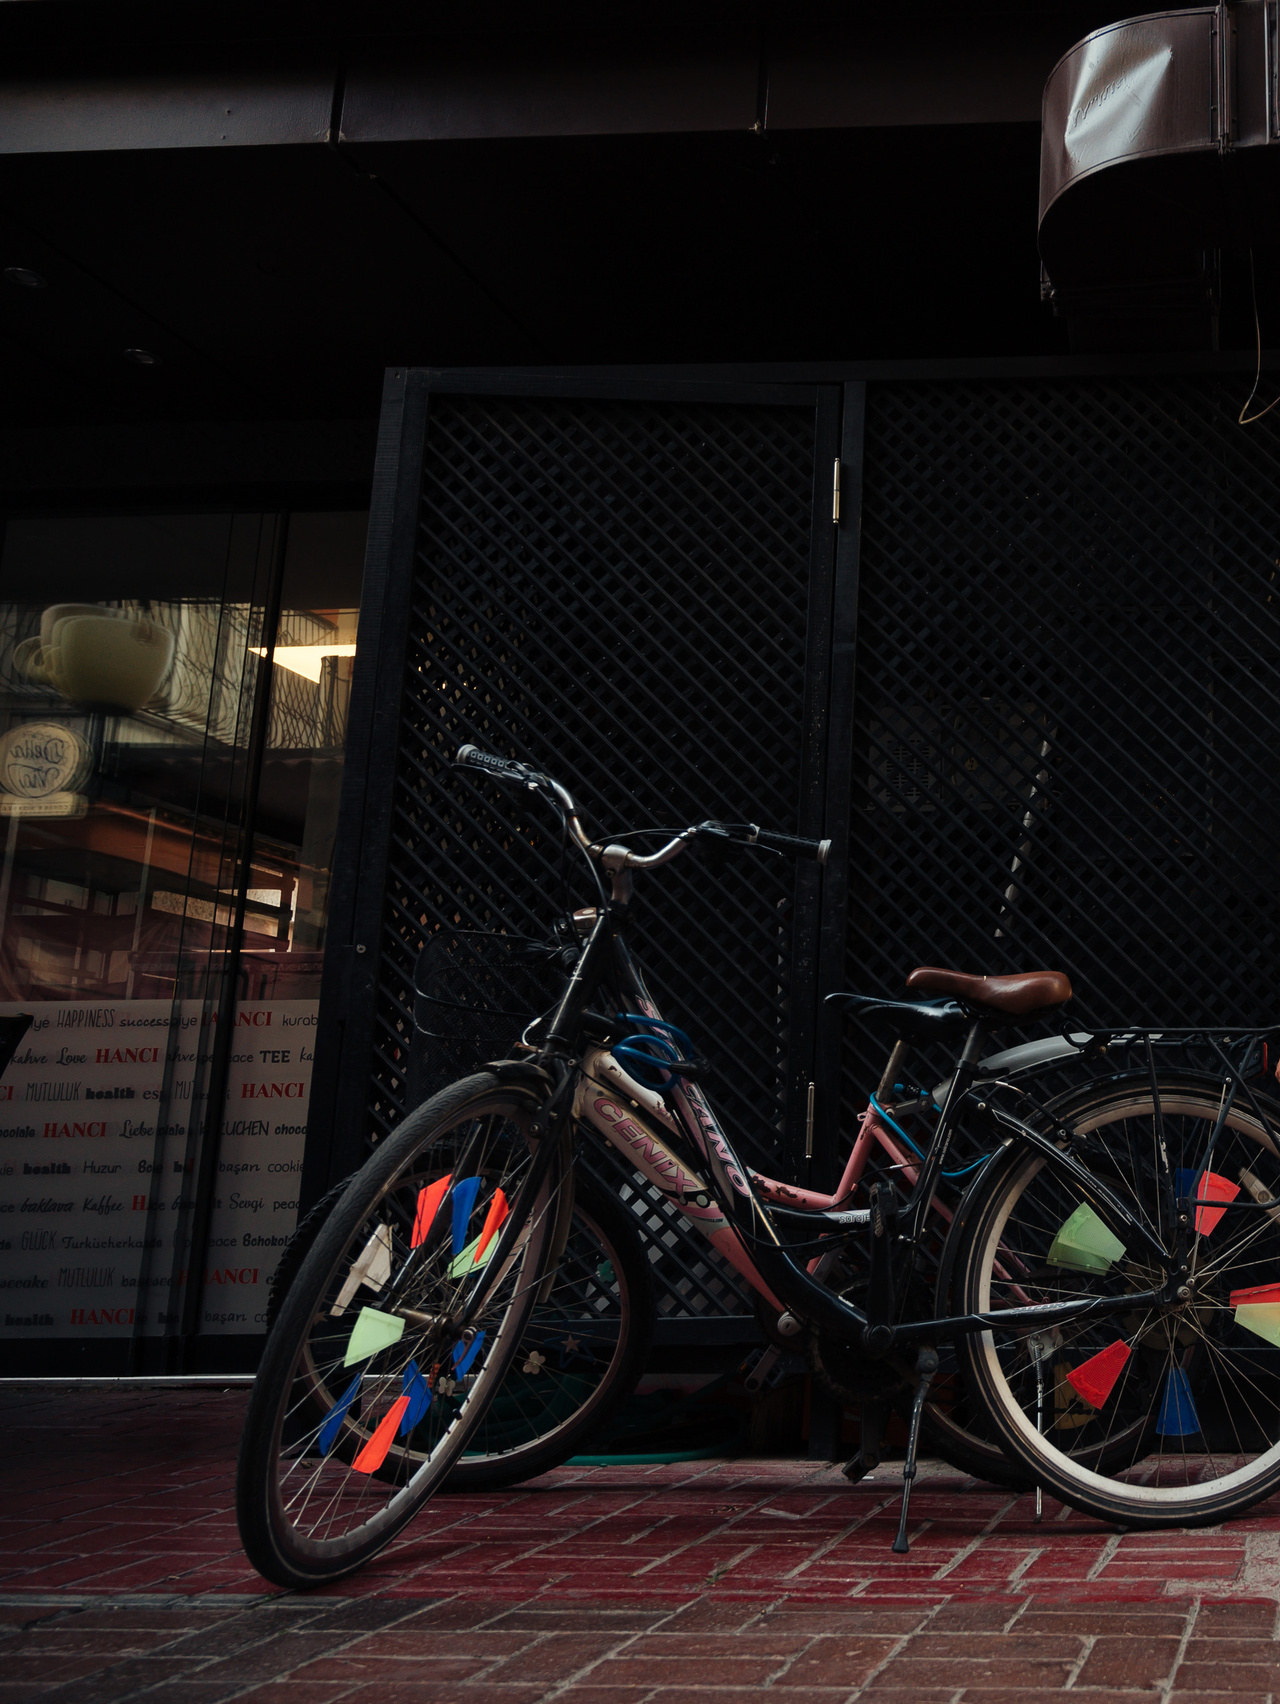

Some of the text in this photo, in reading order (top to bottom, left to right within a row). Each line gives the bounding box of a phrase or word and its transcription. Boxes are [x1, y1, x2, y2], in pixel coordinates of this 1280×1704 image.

[57, 1008, 116, 1028] HAPPINESS
[119, 1017, 170, 1028] success
[56, 1047, 88, 1065] Love
[95, 1047, 160, 1064] HANCI
[260, 1050, 291, 1064] TEE
[25, 1081, 82, 1102] MUTLULUK
[86, 1087, 136, 1101] health
[240, 1082, 305, 1099] HANCI
[43, 1121, 108, 1139] HANCI
[119, 1119, 154, 1139] Liebe
[594, 1097, 699, 1197] CENIX
[23, 1162, 71, 1175] health
[83, 1160, 122, 1174] Huzur
[20, 1196, 74, 1213] baklava
[83, 1194, 124, 1215] Kaffee
[229, 1192, 265, 1214] Sevgi
[21, 1227, 58, 1251] GLÜCK
[58, 1266, 116, 1288] MUTLULUK
[4, 1313, 54, 1327] health
[70, 1307, 135, 1325] HANCI
